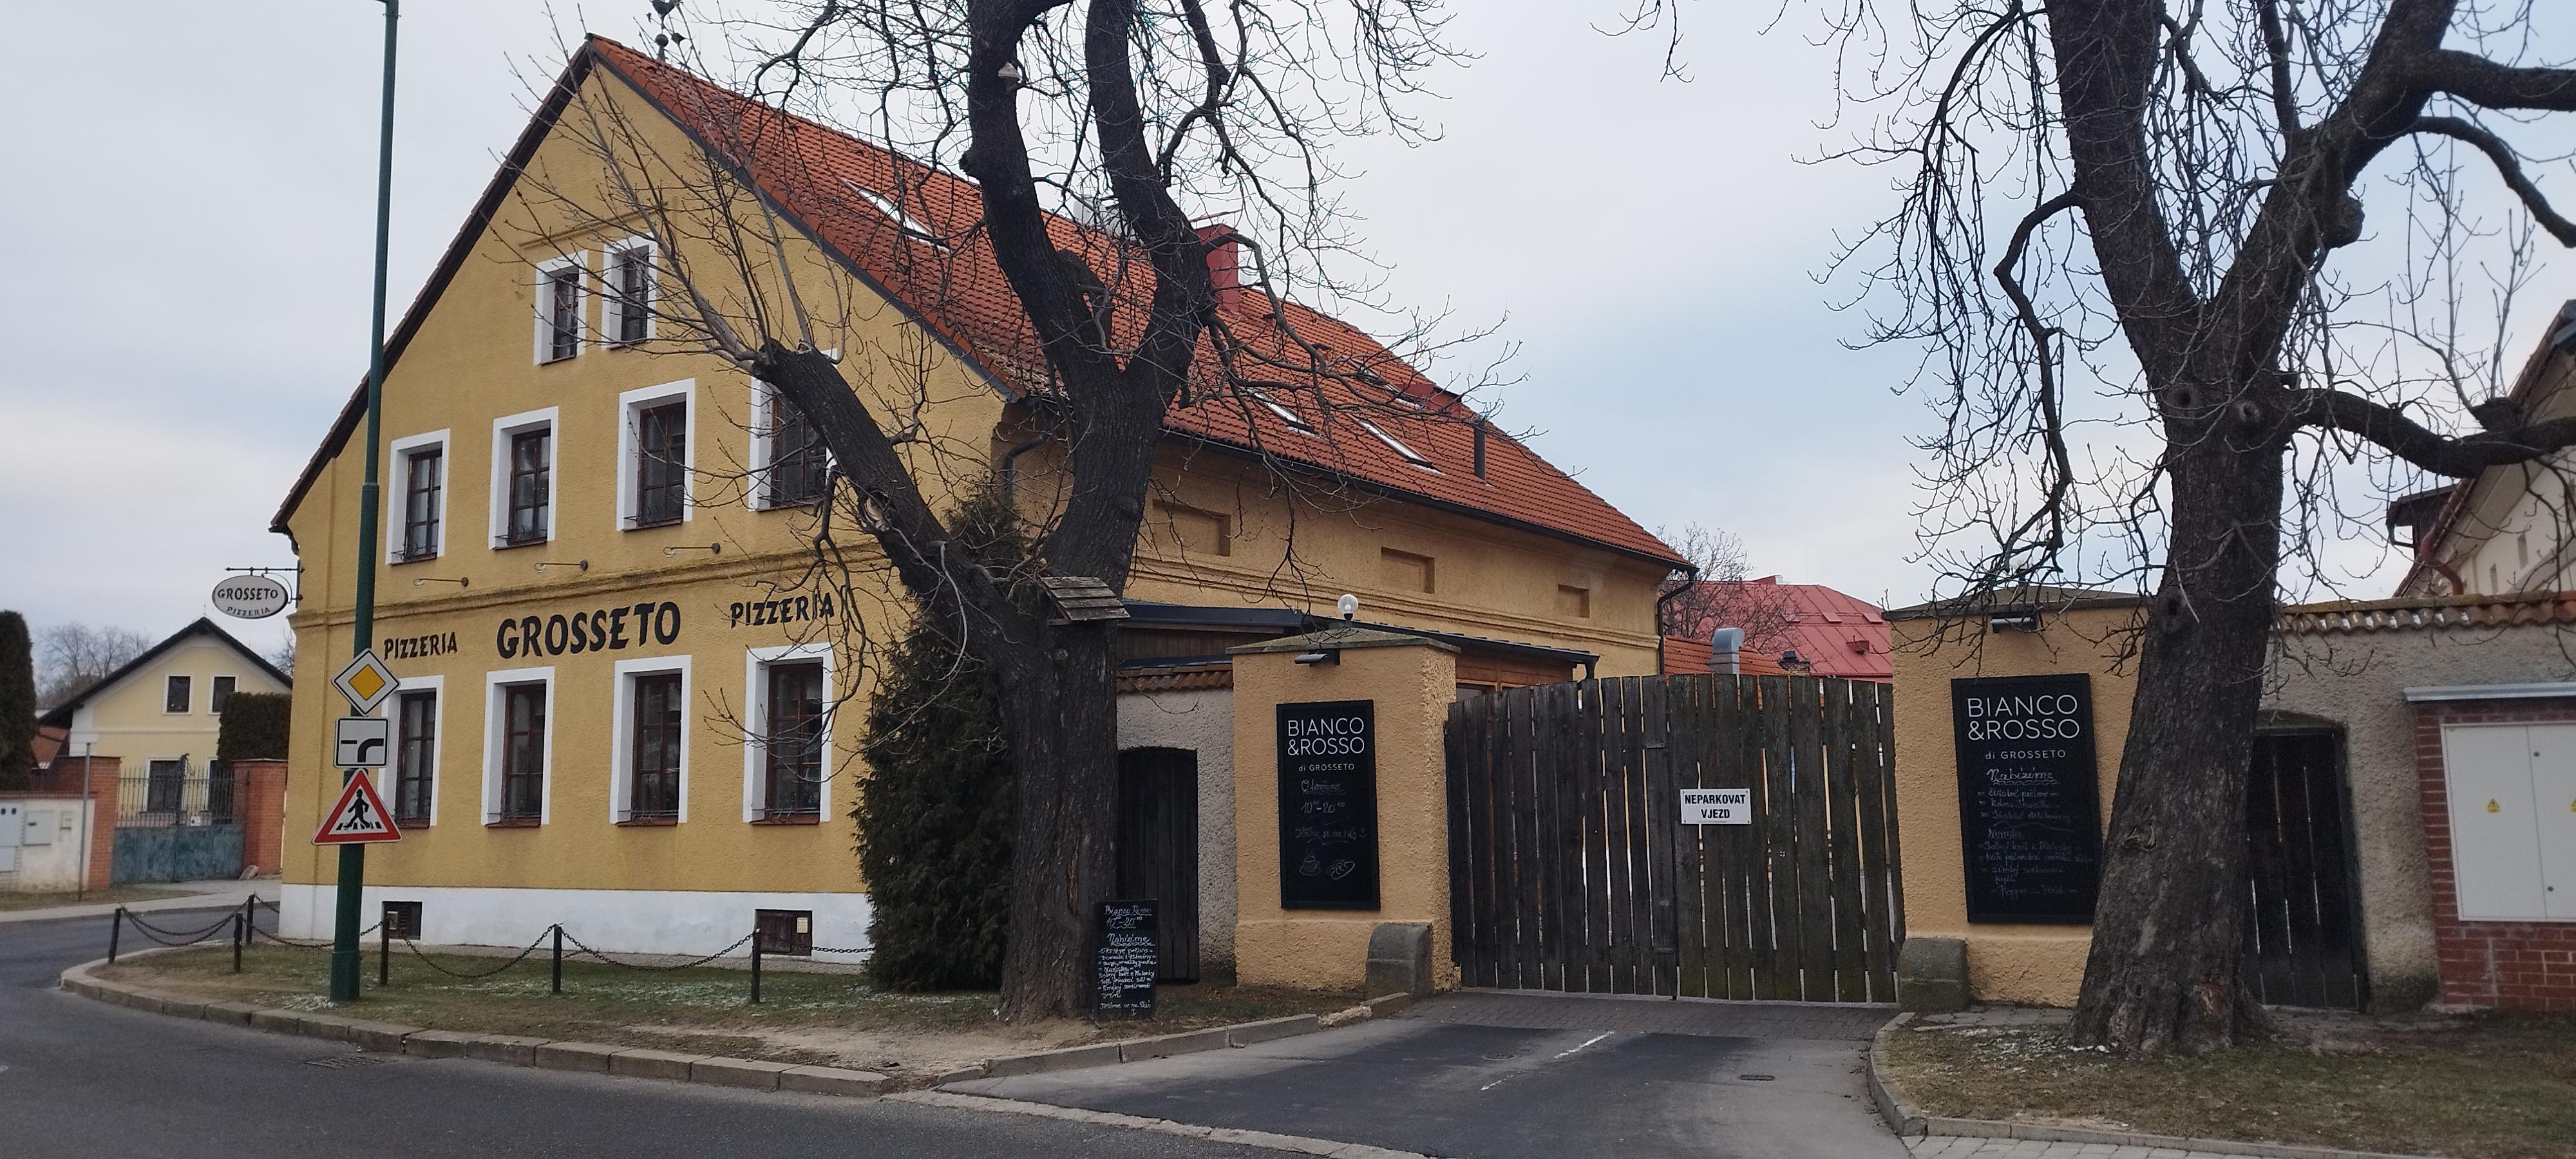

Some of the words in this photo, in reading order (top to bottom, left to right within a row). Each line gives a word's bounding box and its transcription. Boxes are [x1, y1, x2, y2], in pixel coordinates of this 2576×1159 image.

[217, 587, 278, 601] GROSSETO
[226, 606, 270, 616] PIZZERIA
[730, 592, 835, 629] PIZZERIA
[497, 601, 681, 659] GROSSETO
[383, 632, 458, 660] PIZZERIA
[1967, 694, 2078, 717] BIANCO
[1288, 717, 1364, 736] BIANCO
[1968, 719, 2079, 740] &ROSSO
[1287, 737, 1365, 756] &ROSSO
[1985, 751, 1996, 760] di
[2000, 749, 2066, 759] GROSSETO
[1309, 763, 1355, 771] GROSSETO
[1685, 794, 1746, 804] NEPARKOVAT
[1701, 809, 1730, 818] VJEZD
